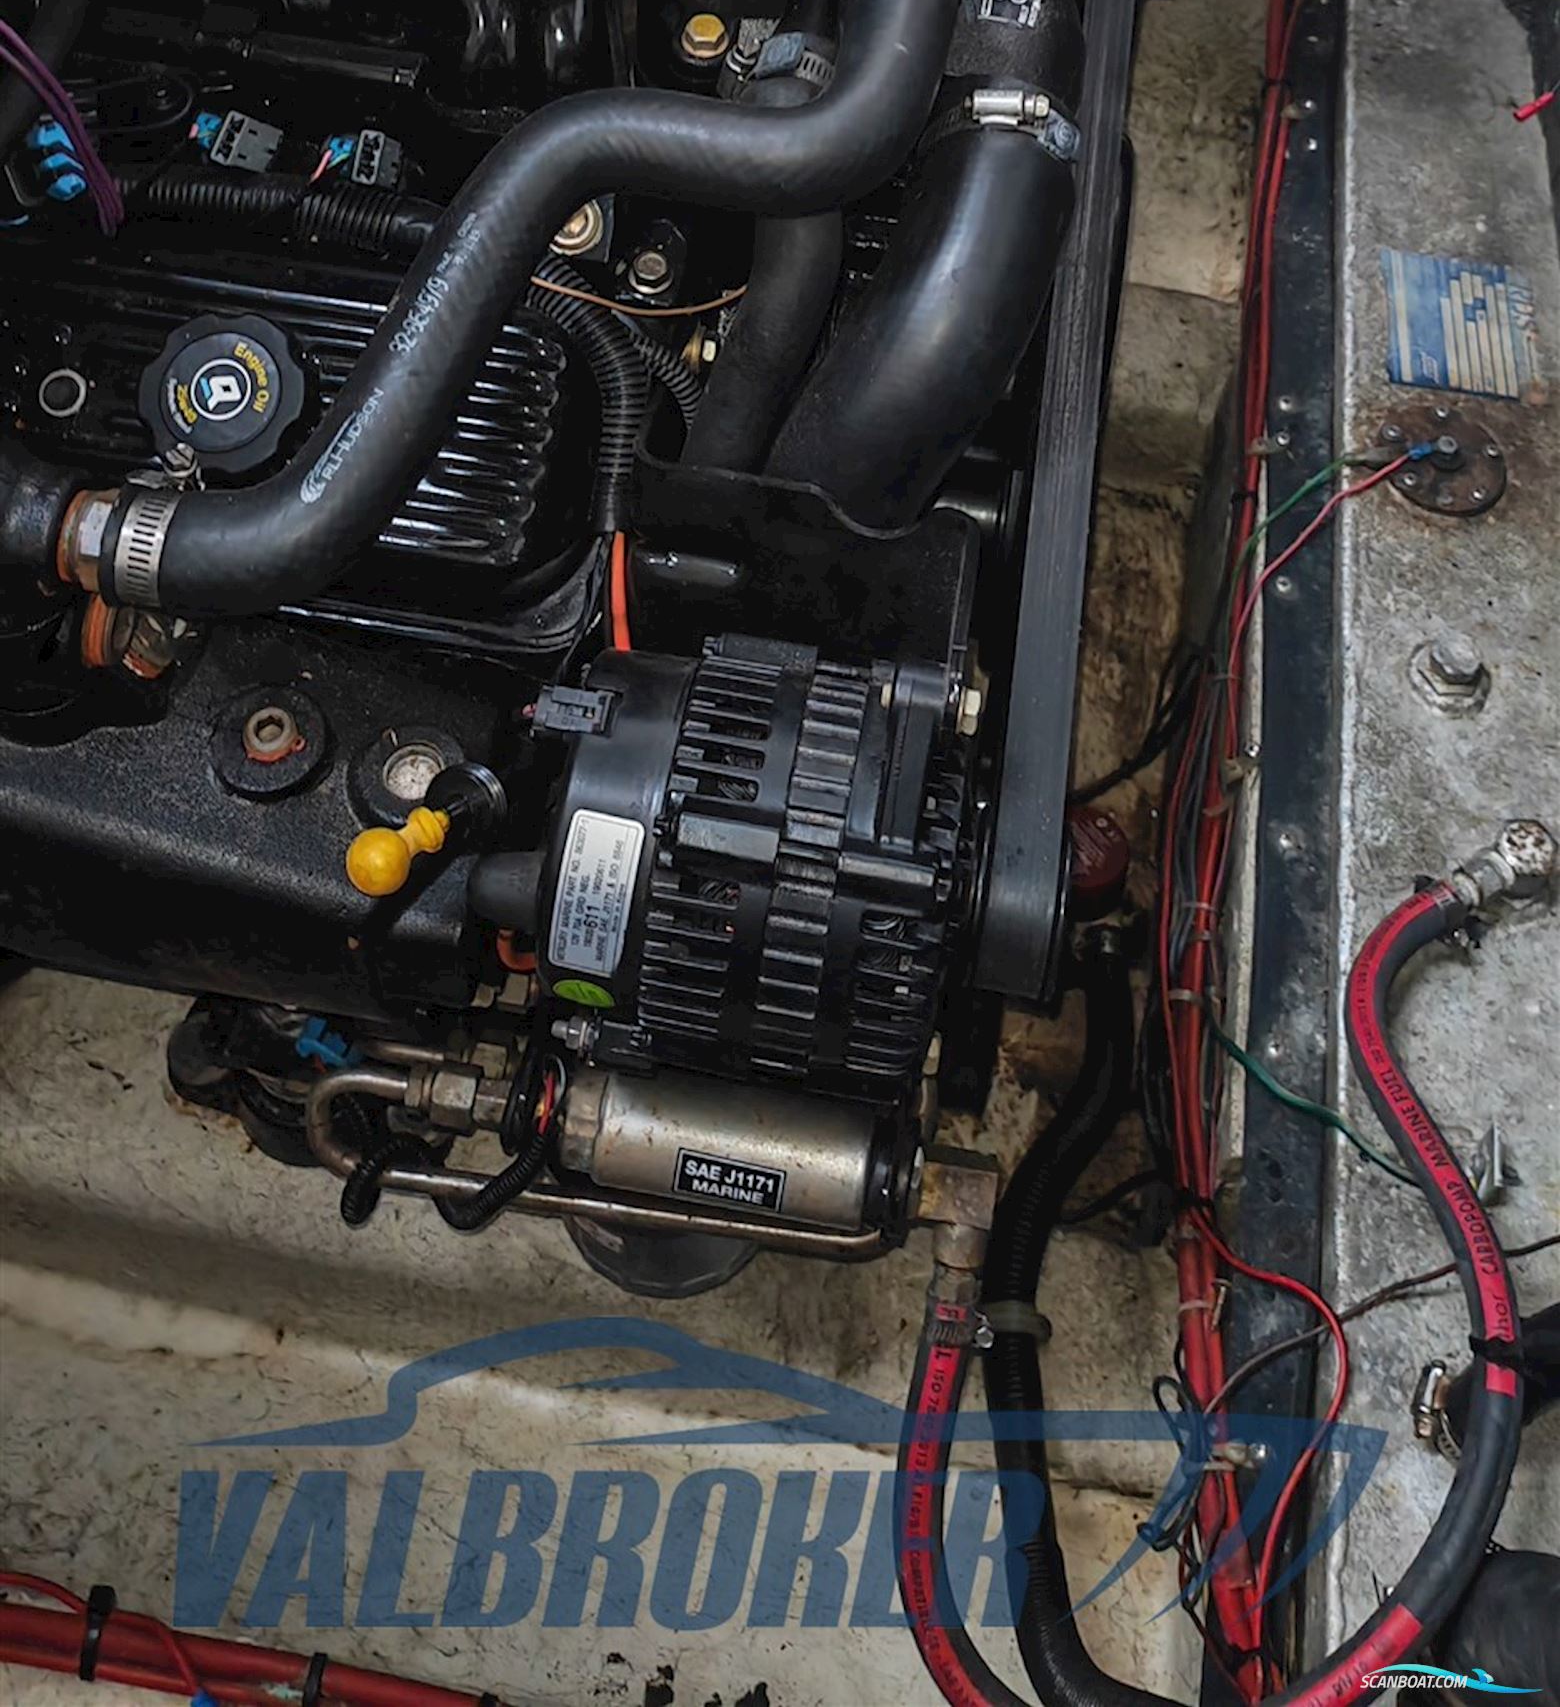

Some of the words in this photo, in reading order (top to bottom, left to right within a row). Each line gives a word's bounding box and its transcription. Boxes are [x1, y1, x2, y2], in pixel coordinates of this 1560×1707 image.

[234, 341, 268, 387] Engine
[253, 389, 270, 413] Oil
[566, 876, 578, 897] PART
[1379, 1068, 1412, 1106] FUEL
[1399, 1104, 1450, 1170] MARINE
[684, 1159, 722, 1182] SAE
[724, 1169, 775, 1193] J1171
[692, 1178, 764, 1205] MARINE
